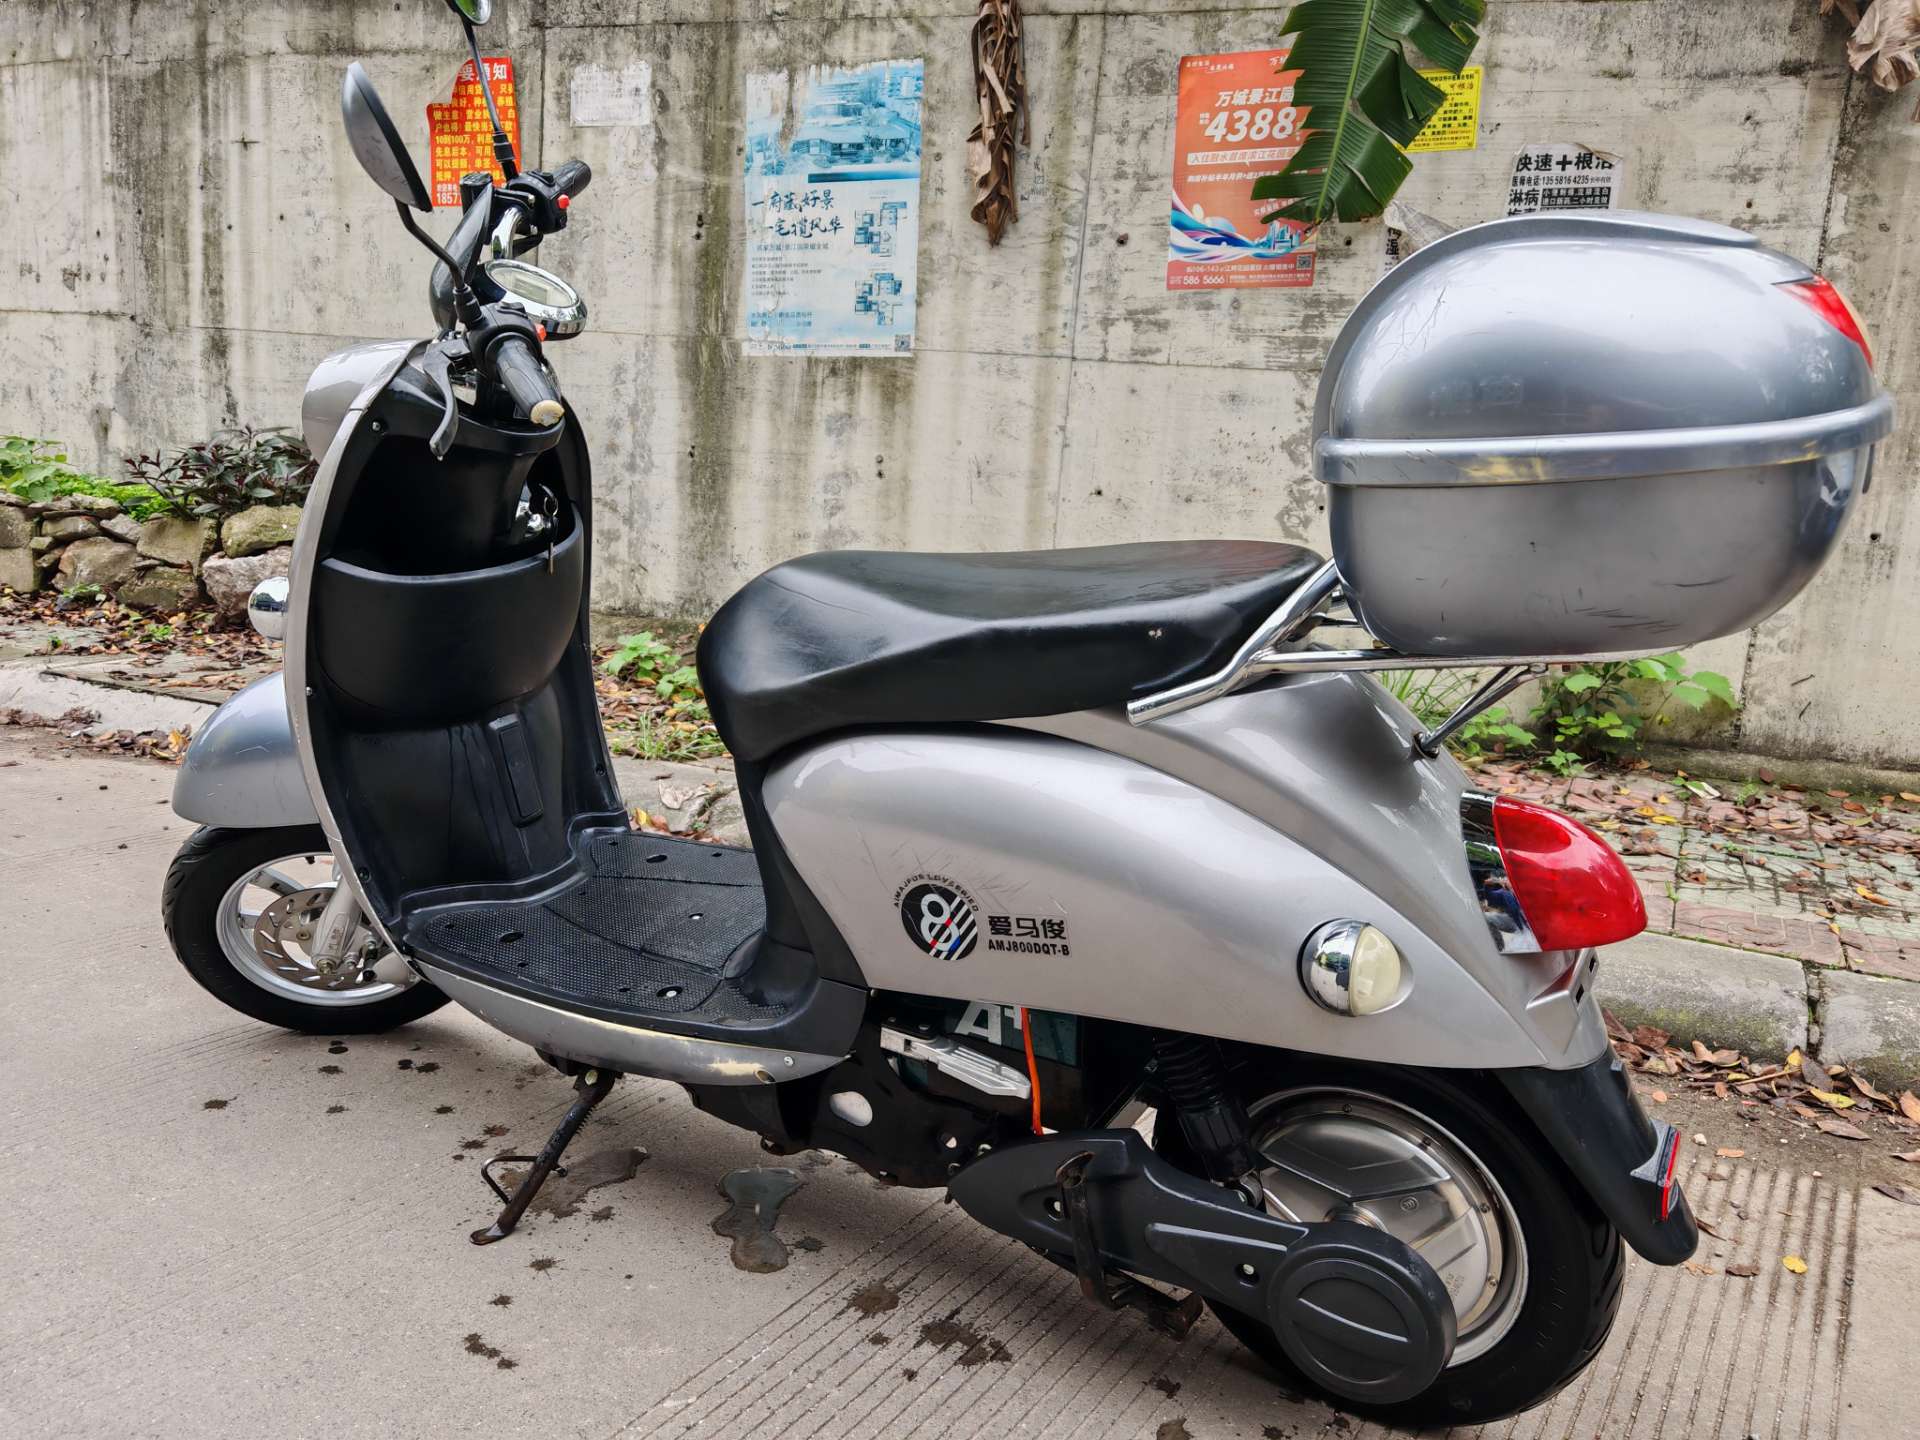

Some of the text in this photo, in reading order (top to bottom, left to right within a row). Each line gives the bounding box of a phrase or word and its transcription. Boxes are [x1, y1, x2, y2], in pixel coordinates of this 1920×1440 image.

[1204, 107, 1296, 143] 4388
[1508, 188, 1539, 206] 淋病
[1183, 275, 1200, 285] 586
[1203, 275, 1225, 285] 5666
[988, 915, 1067, 940] 爱马俊
